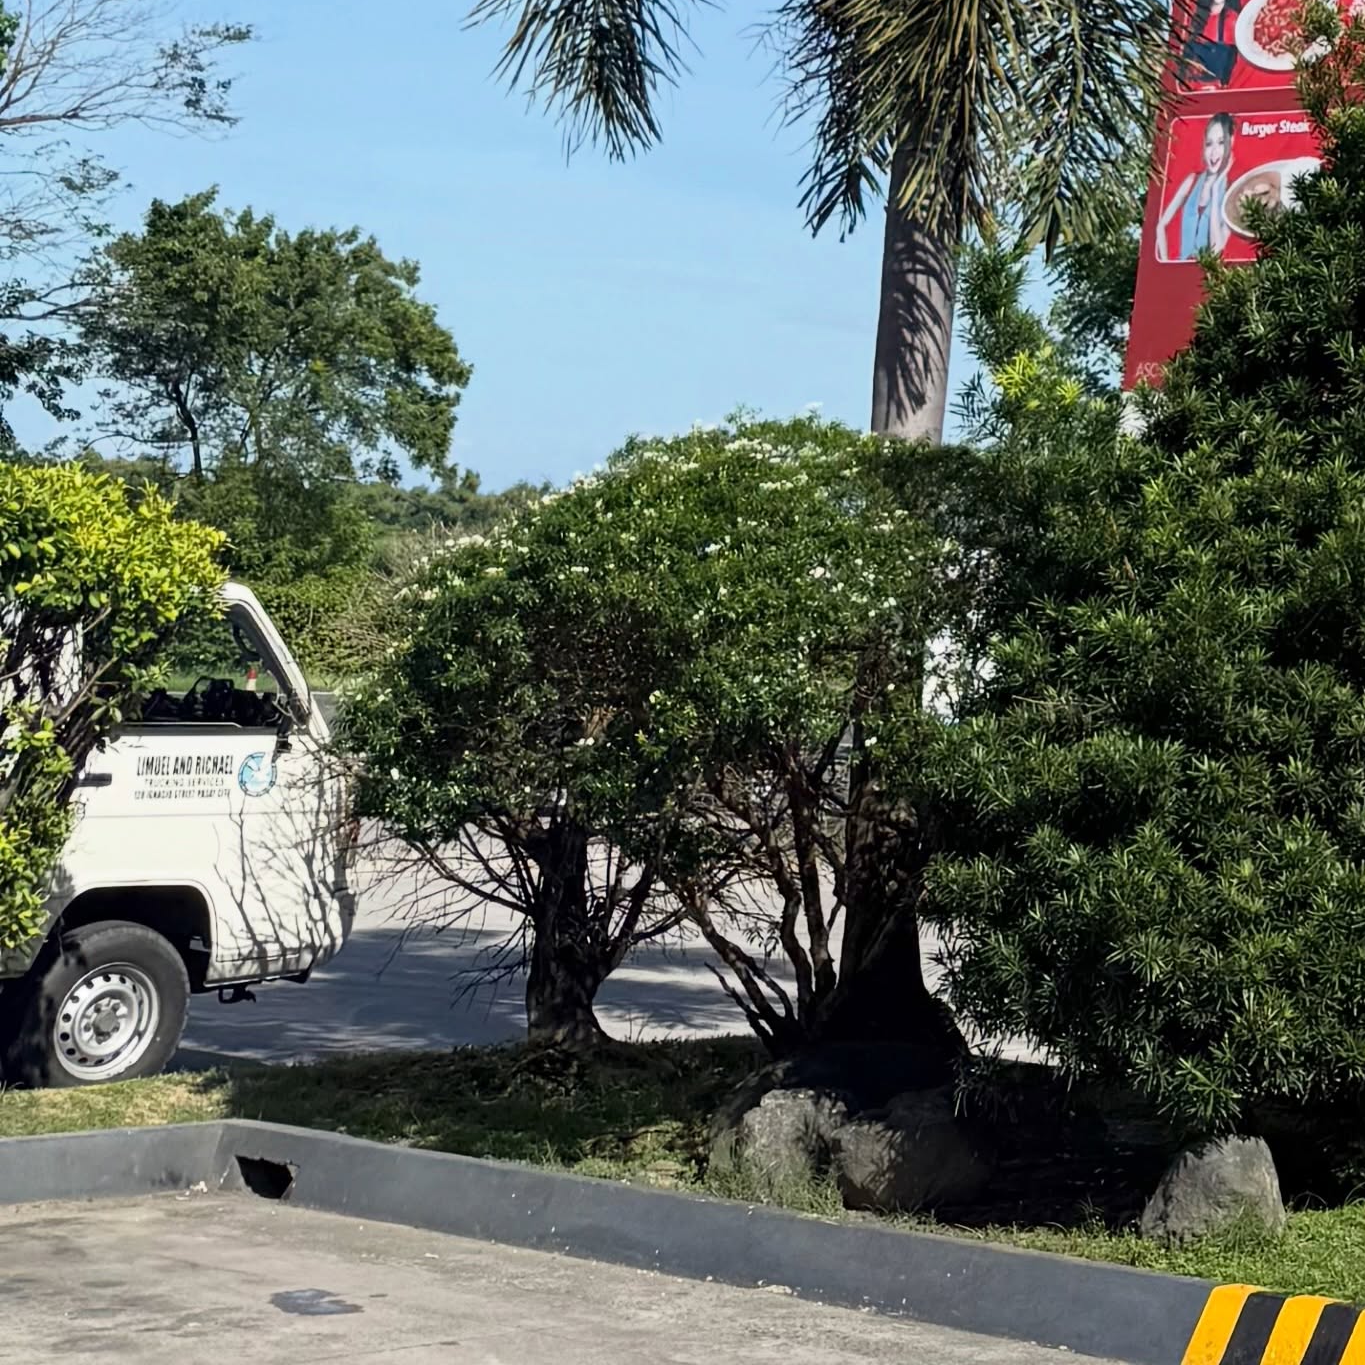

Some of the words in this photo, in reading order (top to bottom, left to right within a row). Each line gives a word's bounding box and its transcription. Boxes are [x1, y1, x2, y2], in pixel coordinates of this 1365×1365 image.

[1241, 121, 1278, 139] Burger
[136, 755, 170, 777] LIMUEL
[172, 755, 193, 776] AND
